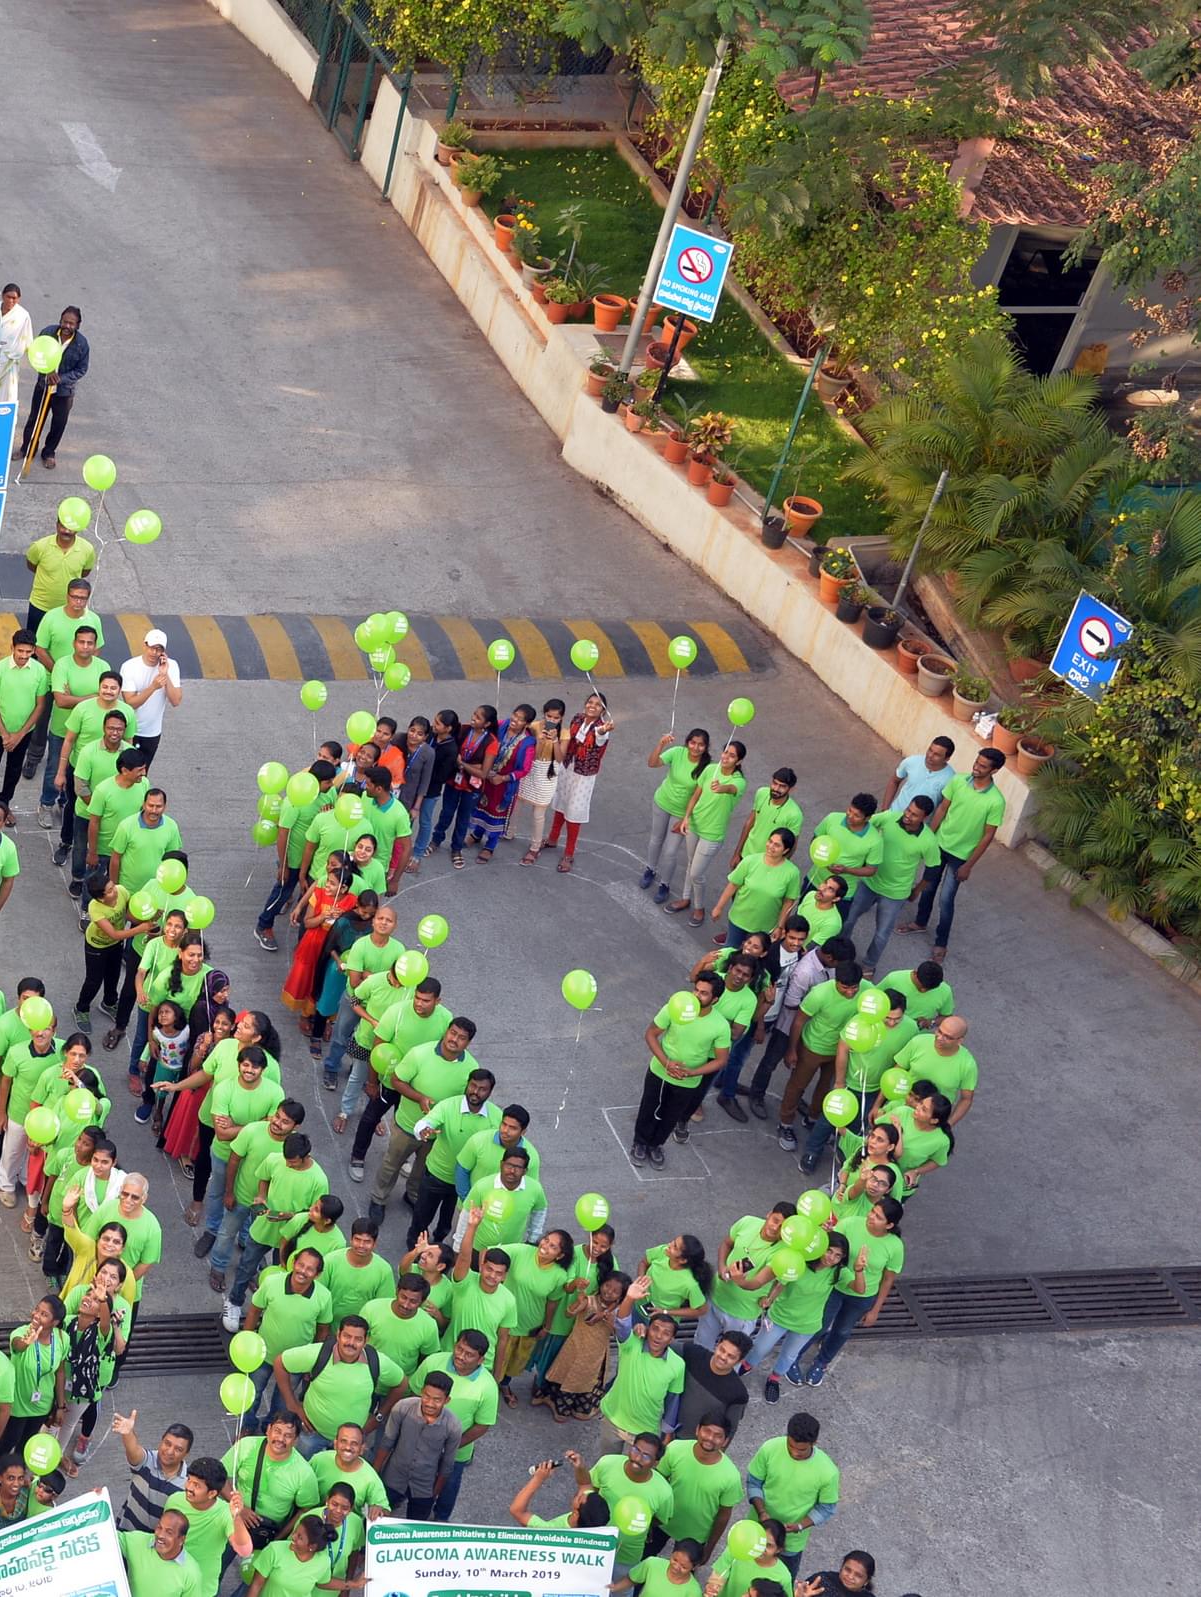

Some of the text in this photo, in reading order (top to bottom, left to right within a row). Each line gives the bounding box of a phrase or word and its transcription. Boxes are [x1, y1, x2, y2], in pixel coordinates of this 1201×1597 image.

[671, 282, 699, 298] SMOKING
[699, 292, 715, 303] AREA
[1072, 652, 1099, 677] EXIT
[57, 1531, 101, 1561] నడక
[374, 1529, 610, 1548] Glaucoma Awareness Initiative to Eliminate Avoidable Blindness
[376, 1548, 605, 1567] GLAUCOMA AWARENESS WALK
[415, 1568, 461, 1579] Sunday,
[490, 1569, 527, 1578] March
[532, 1570, 561, 1579] 2019
